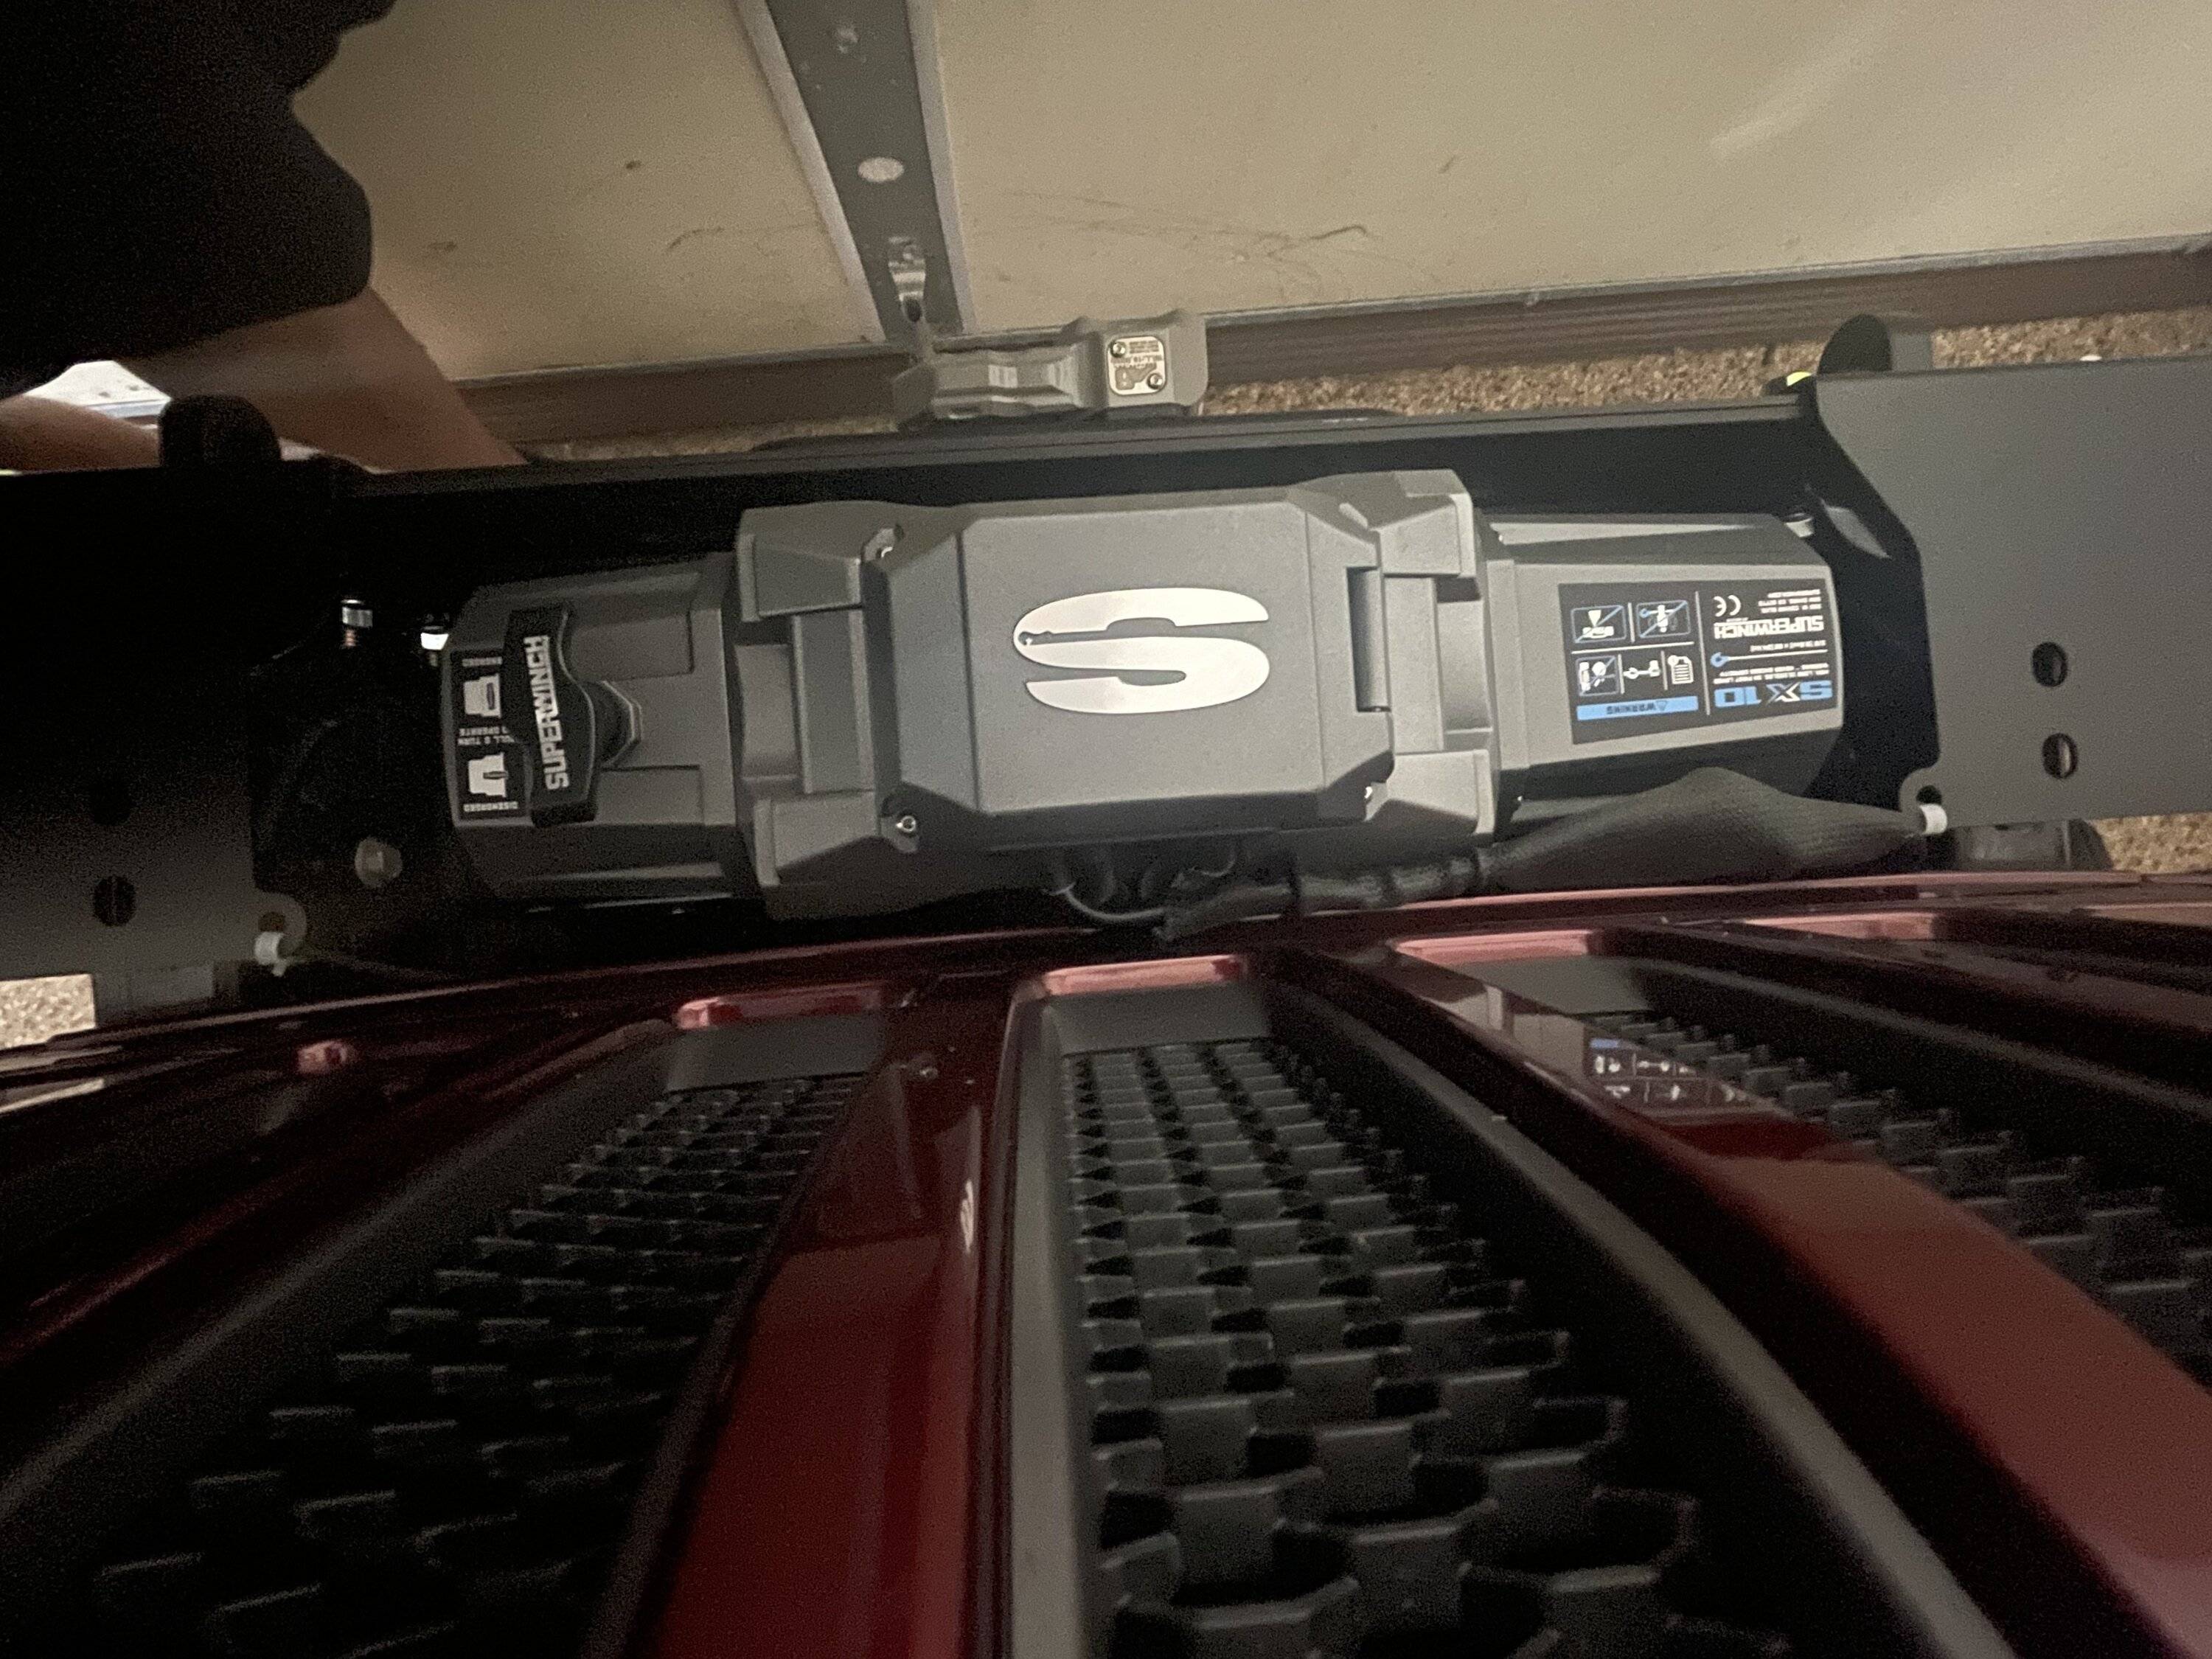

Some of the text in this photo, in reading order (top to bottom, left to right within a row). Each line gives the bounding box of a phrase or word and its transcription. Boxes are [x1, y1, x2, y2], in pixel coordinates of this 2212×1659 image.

[1713, 594, 1742, 617] CE
[1714, 615, 1824, 639] SUPERWINCH
[1013, 587, 1270, 714] S
[1606, 703, 1656, 714] WARNING
[1714, 686, 1762, 708] 10
[524, 635, 570, 790] SUPERWINCH
